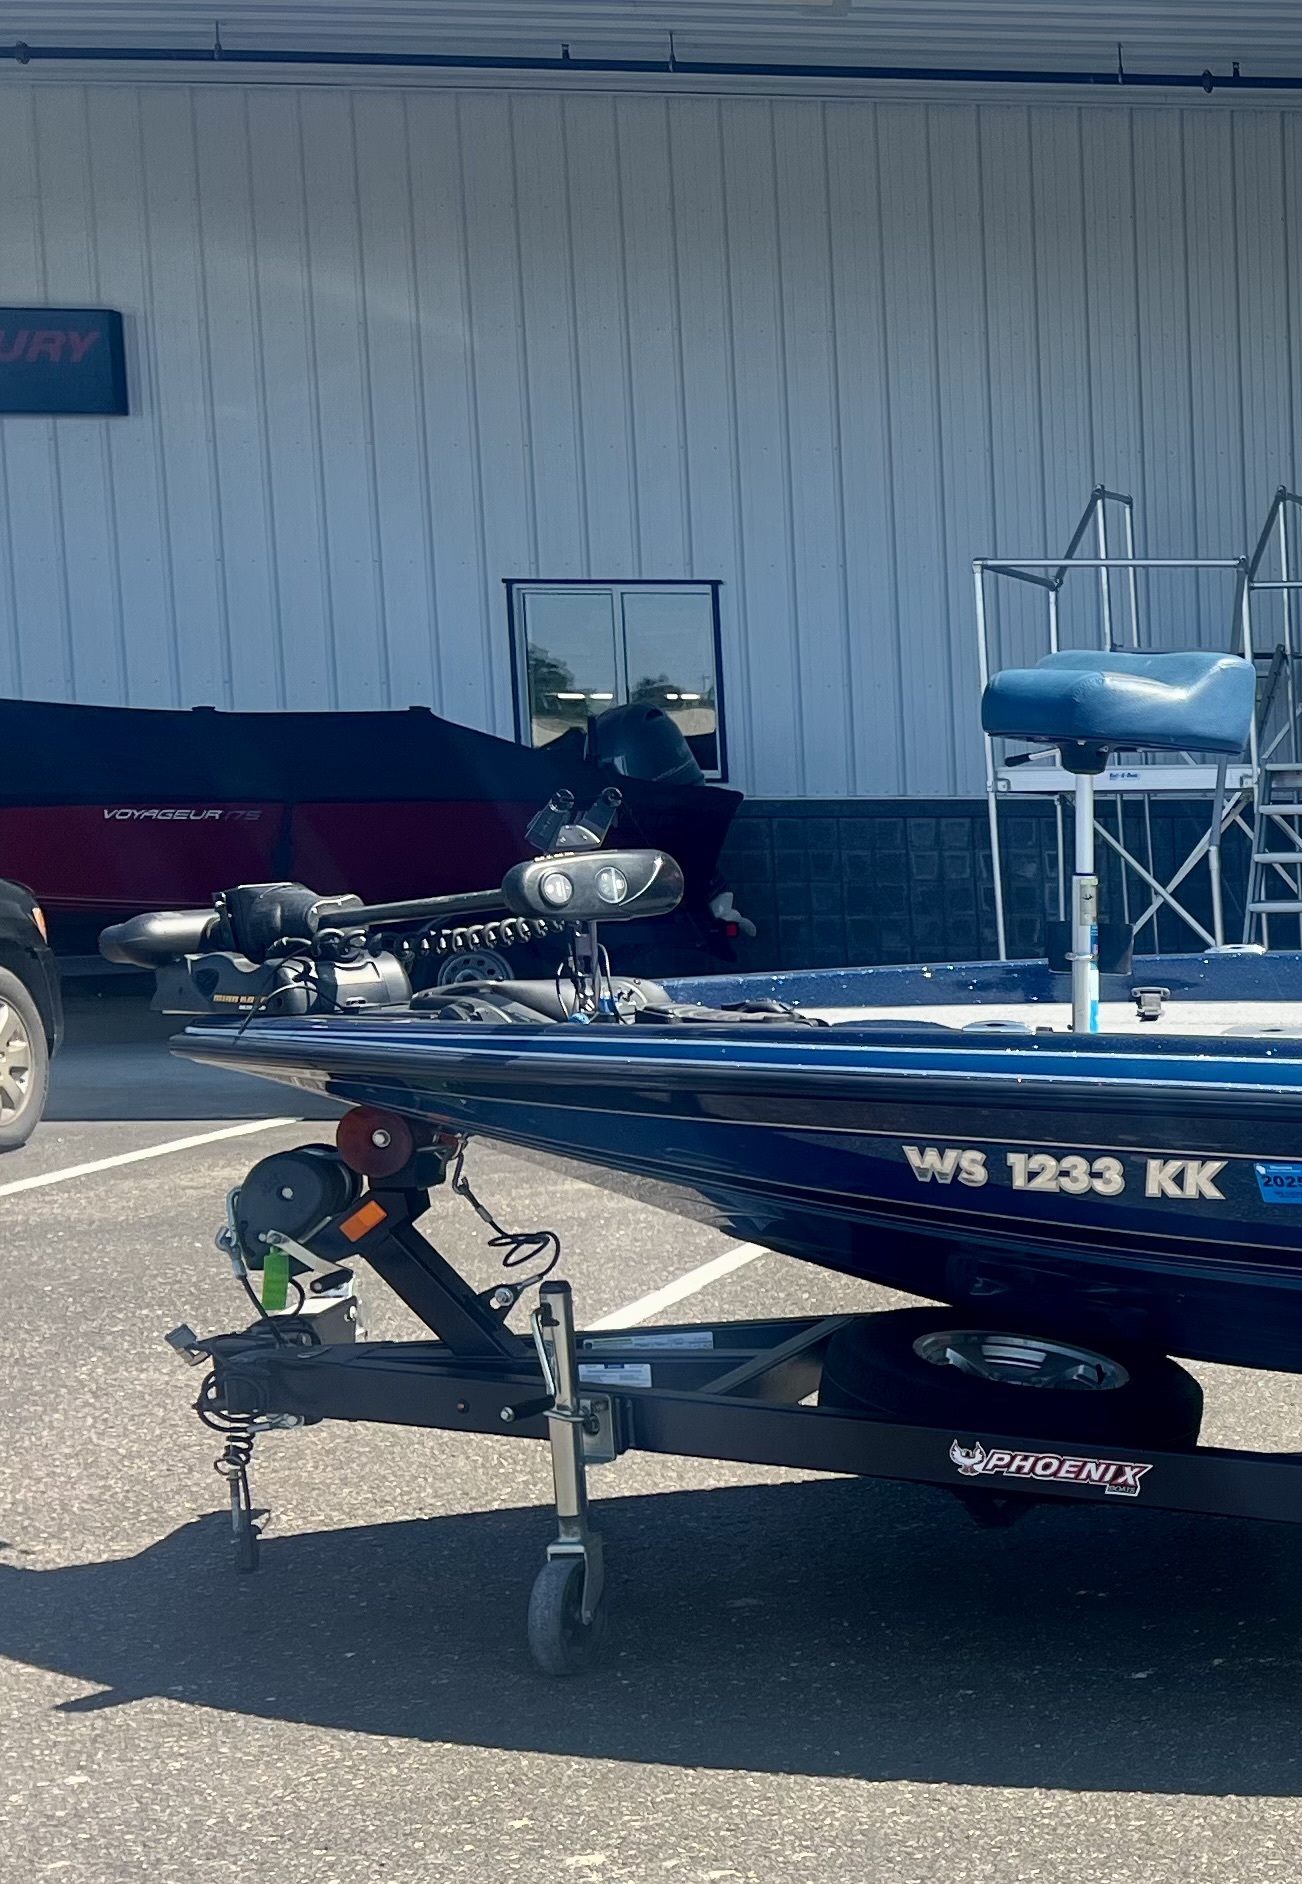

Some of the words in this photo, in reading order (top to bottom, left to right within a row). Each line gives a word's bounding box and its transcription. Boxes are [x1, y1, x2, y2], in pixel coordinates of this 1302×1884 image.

[103, 808, 224, 821] VOYAGEUR
[902, 1145, 989, 1187] WS
[1006, 1152, 1126, 1196] 1233
[1144, 1159, 1230, 1200] KK
[984, 1450, 1150, 1486] PHOENIX
[1107, 1484, 1137, 1494] BOATS
